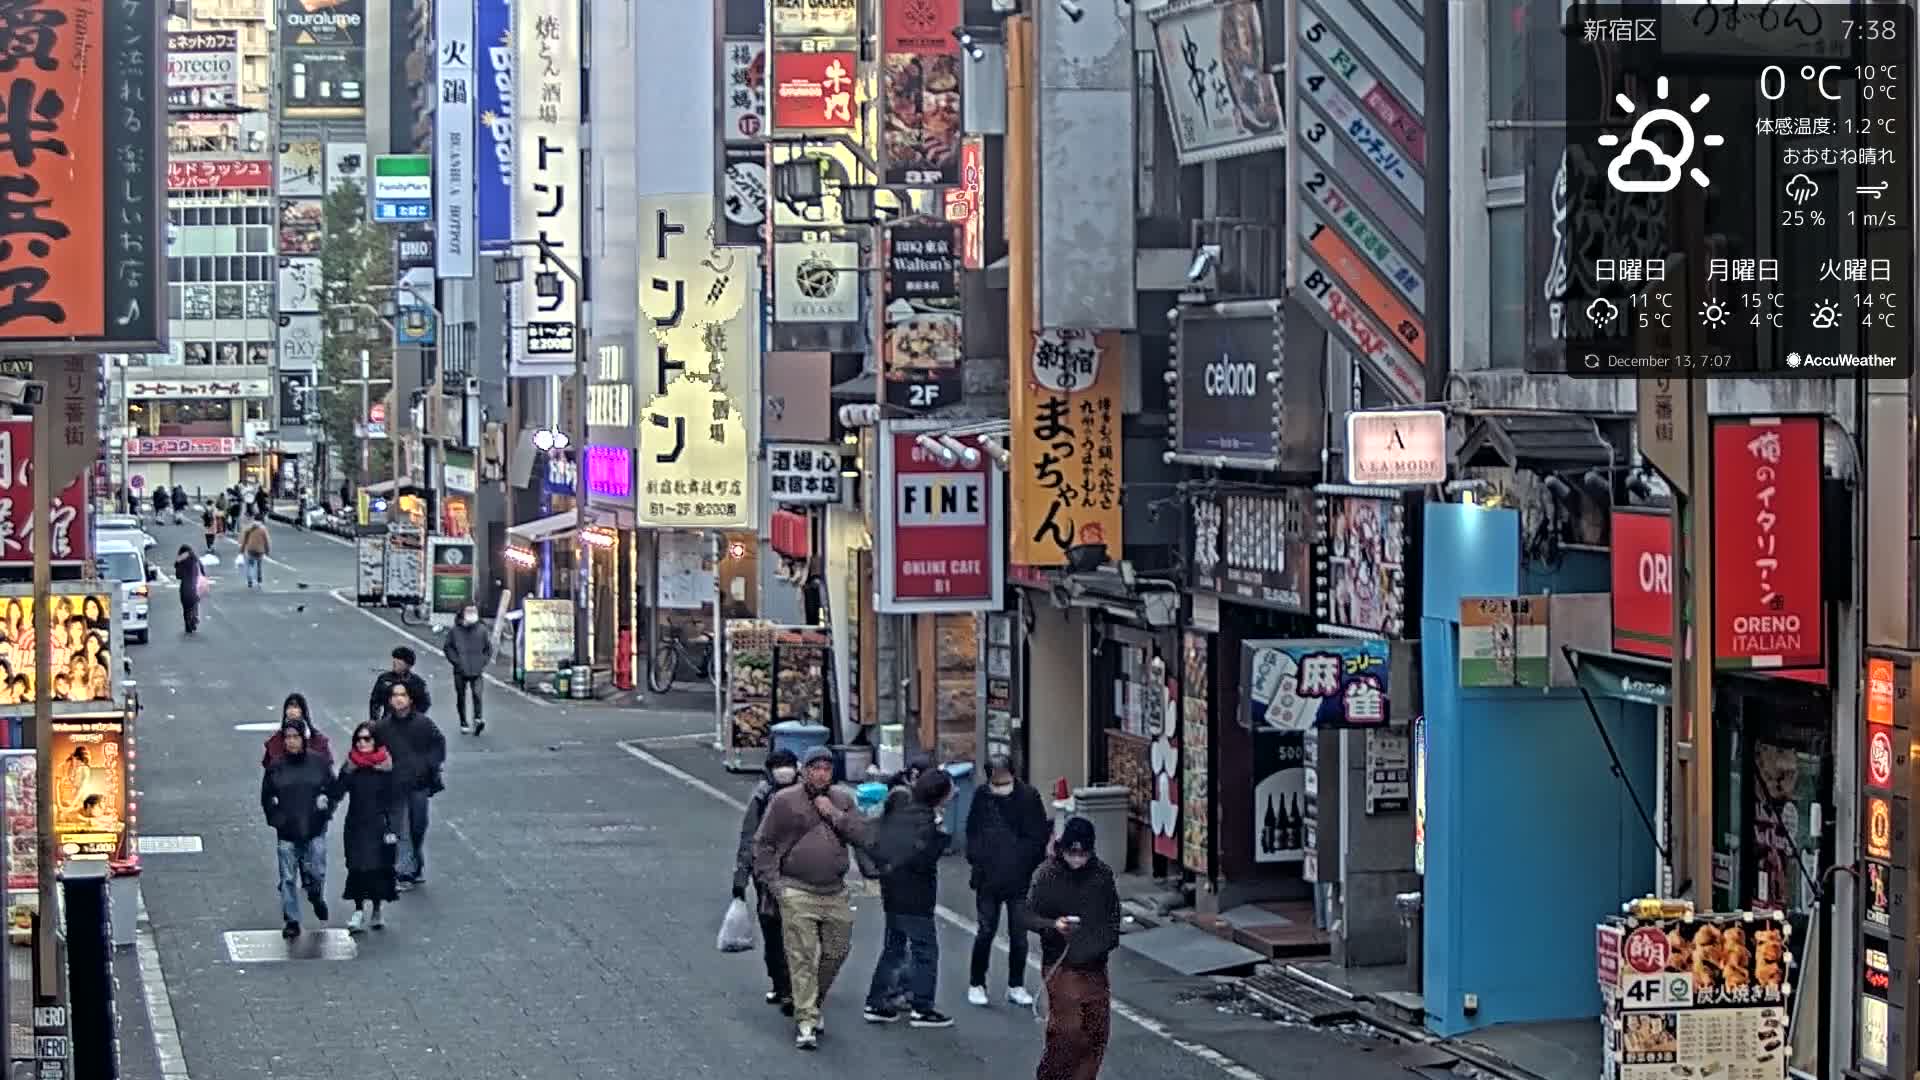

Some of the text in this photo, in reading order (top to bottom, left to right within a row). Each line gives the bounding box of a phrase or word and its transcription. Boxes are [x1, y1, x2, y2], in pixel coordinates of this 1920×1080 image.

[288, 12, 361, 26] auralume
[1306, 22, 1327, 43] 5
[443, 39, 467, 104] 火鍋
[1307, 74, 1326, 93] 4
[1348, 117, 1406, 180] センチュリー
[1308, 123, 1326, 143] 3
[378, 183, 428, 193] FamilyMart
[1306, 172, 1326, 194] 2
[533, 136, 564, 312] トントン
[893, 257, 953, 272] Walton's
[652, 208, 685, 463] トントン
[1203, 354, 1256, 396] celona
[910, 384, 940, 406] 2F
[772, 475, 836, 493] 新宿本店
[1033, 396, 1079, 551] まっちゃん
[903, 485, 979, 514] FINE
[1747, 431, 1783, 604] 俺のイタリアン
[902, 560, 982, 574] ONLINE CAFE
[1733, 616, 1801, 634] ORENO
[1732, 634, 1802, 652] ITALIAN
[1627, 980, 1662, 1002] 4F
[1696, 984, 1781, 1004] 炭火焼き鳥
[34, 1006, 65, 1027] NERO
[37, 1038, 67, 1057] NERO
